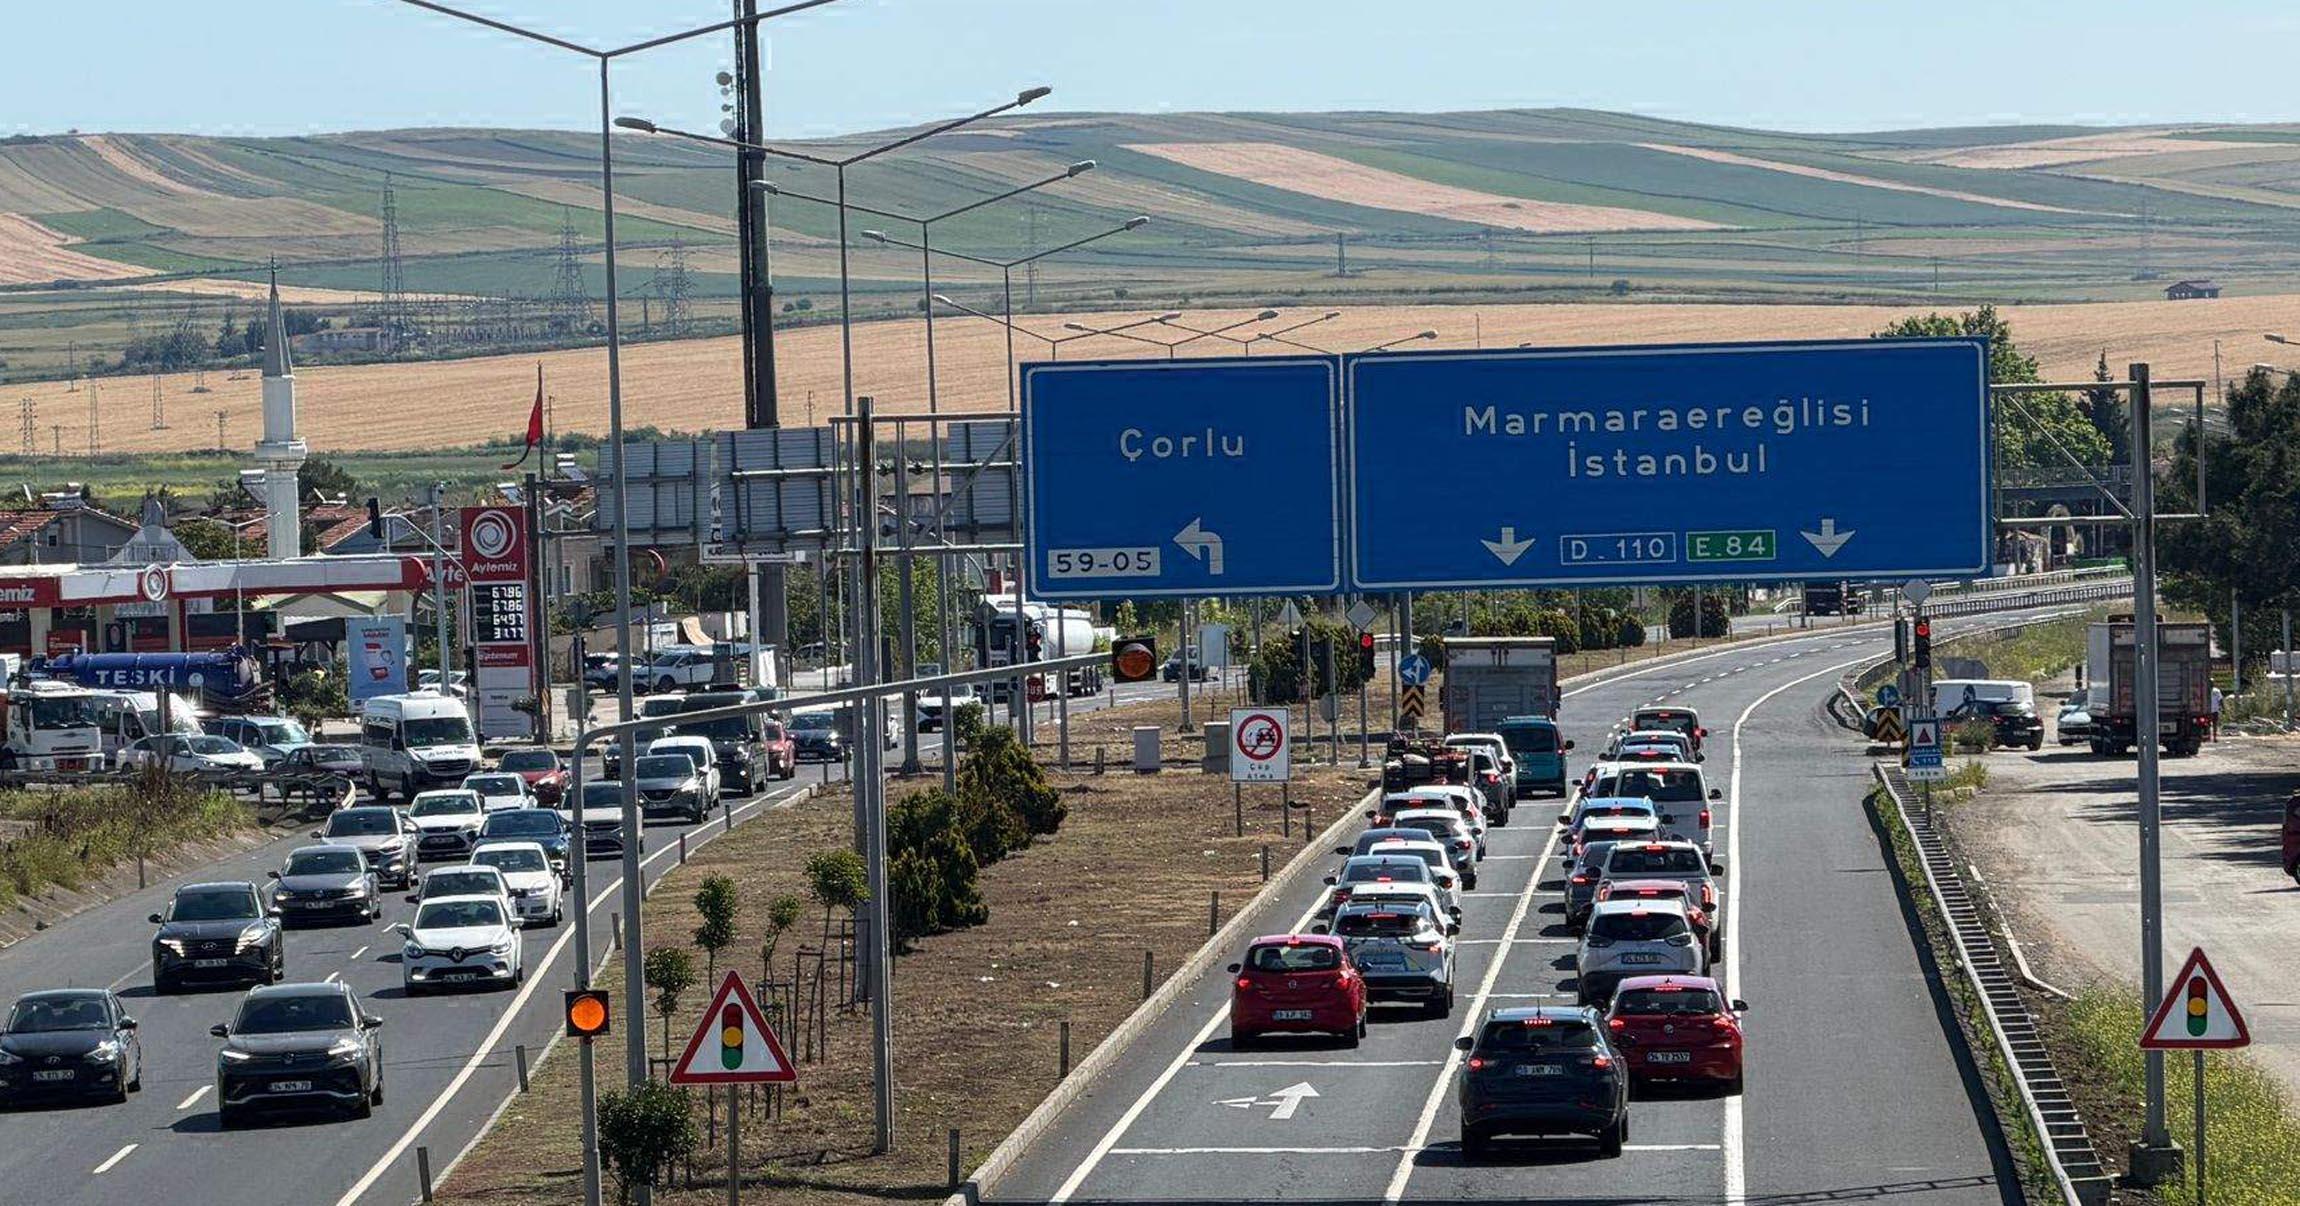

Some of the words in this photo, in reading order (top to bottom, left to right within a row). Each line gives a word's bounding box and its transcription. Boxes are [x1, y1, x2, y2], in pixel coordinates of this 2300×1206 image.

[1464, 398, 1869, 436] Marmaraereğlisi
[1120, 427, 1244, 462] Çorlu
[1568, 440, 1766, 478] İstanbul
[471, 561, 518, 574] Aytemiz
[1056, 551, 1152, 573] 59-05
[96, 666, 175, 685] TESKİ
